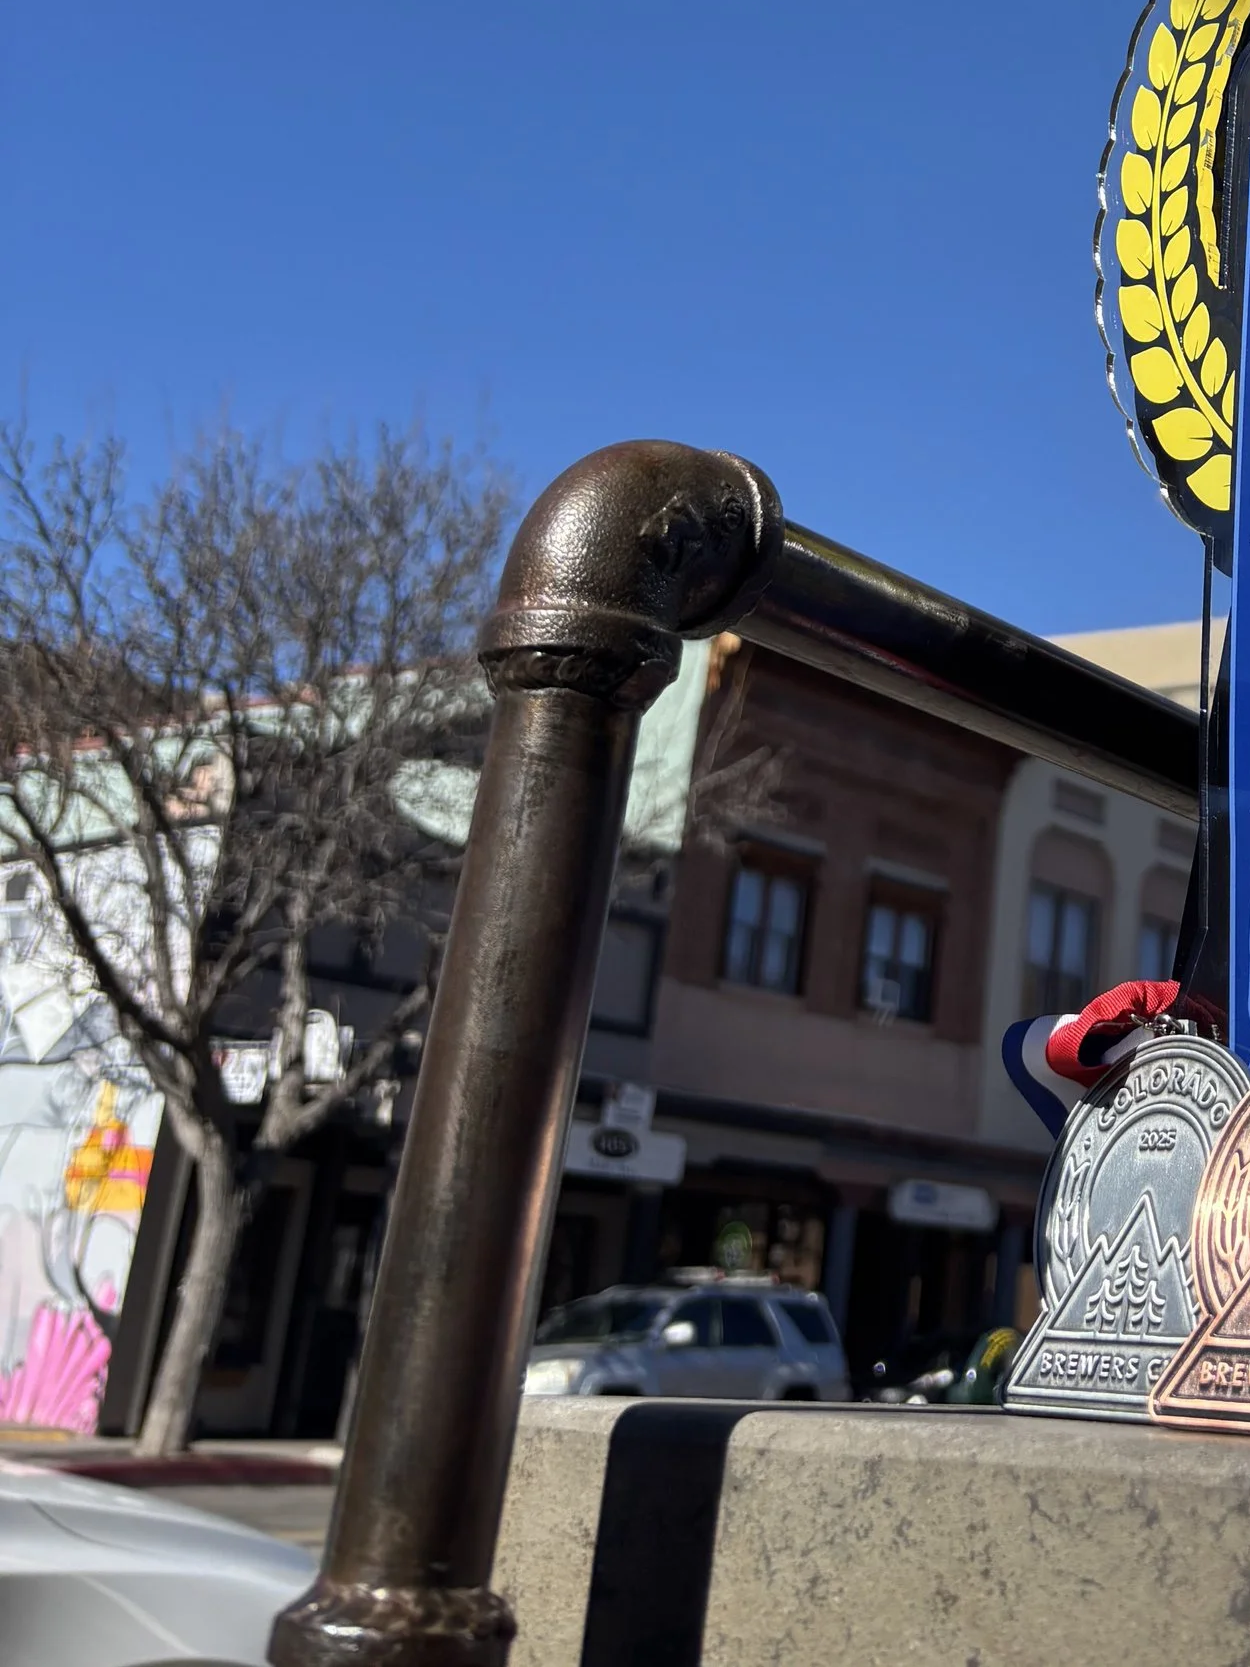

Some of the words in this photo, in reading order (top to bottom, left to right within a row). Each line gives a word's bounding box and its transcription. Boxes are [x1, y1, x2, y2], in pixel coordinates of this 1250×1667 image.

[1097, 1062, 1232, 1131] COLORADO
[1138, 1129, 1177, 1151] 2025
[1040, 1351, 1140, 1381] BREWERS
